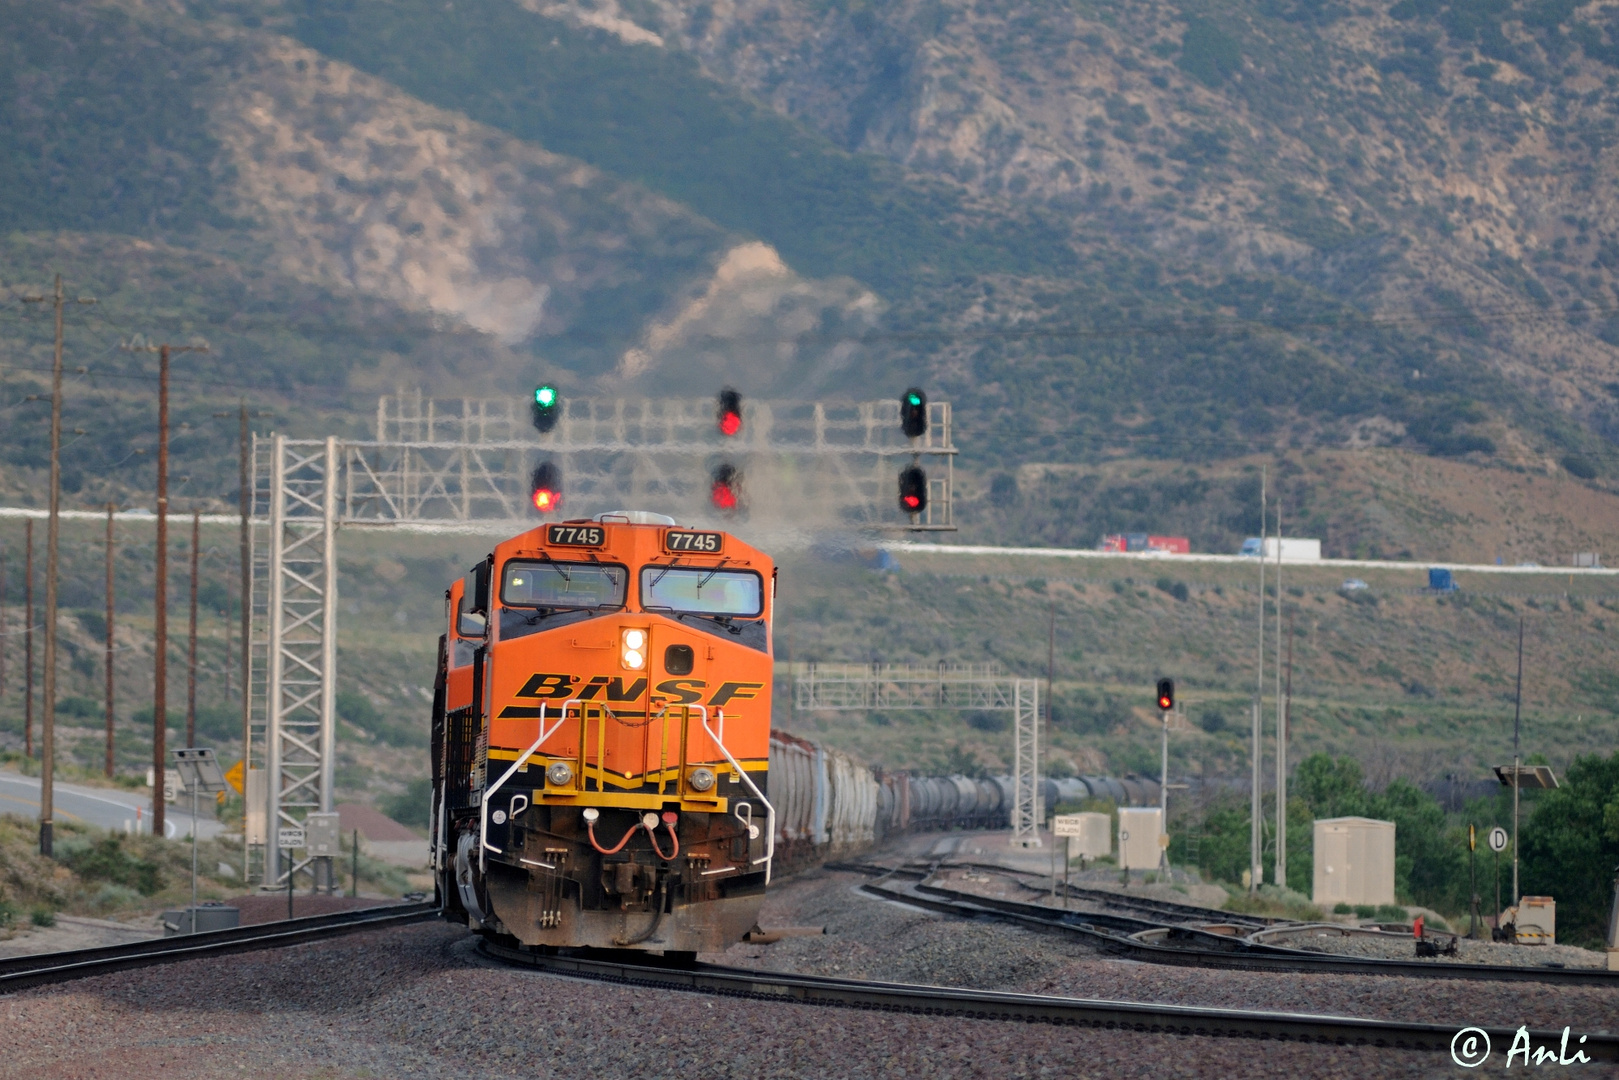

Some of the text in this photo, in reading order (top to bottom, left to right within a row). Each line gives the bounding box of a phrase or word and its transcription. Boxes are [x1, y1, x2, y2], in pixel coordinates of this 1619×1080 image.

[554, 527, 600, 545] 7745
[671, 533, 716, 550] 7745
[514, 673, 767, 707] BNSF
[1495, 830, 1505, 848] D
